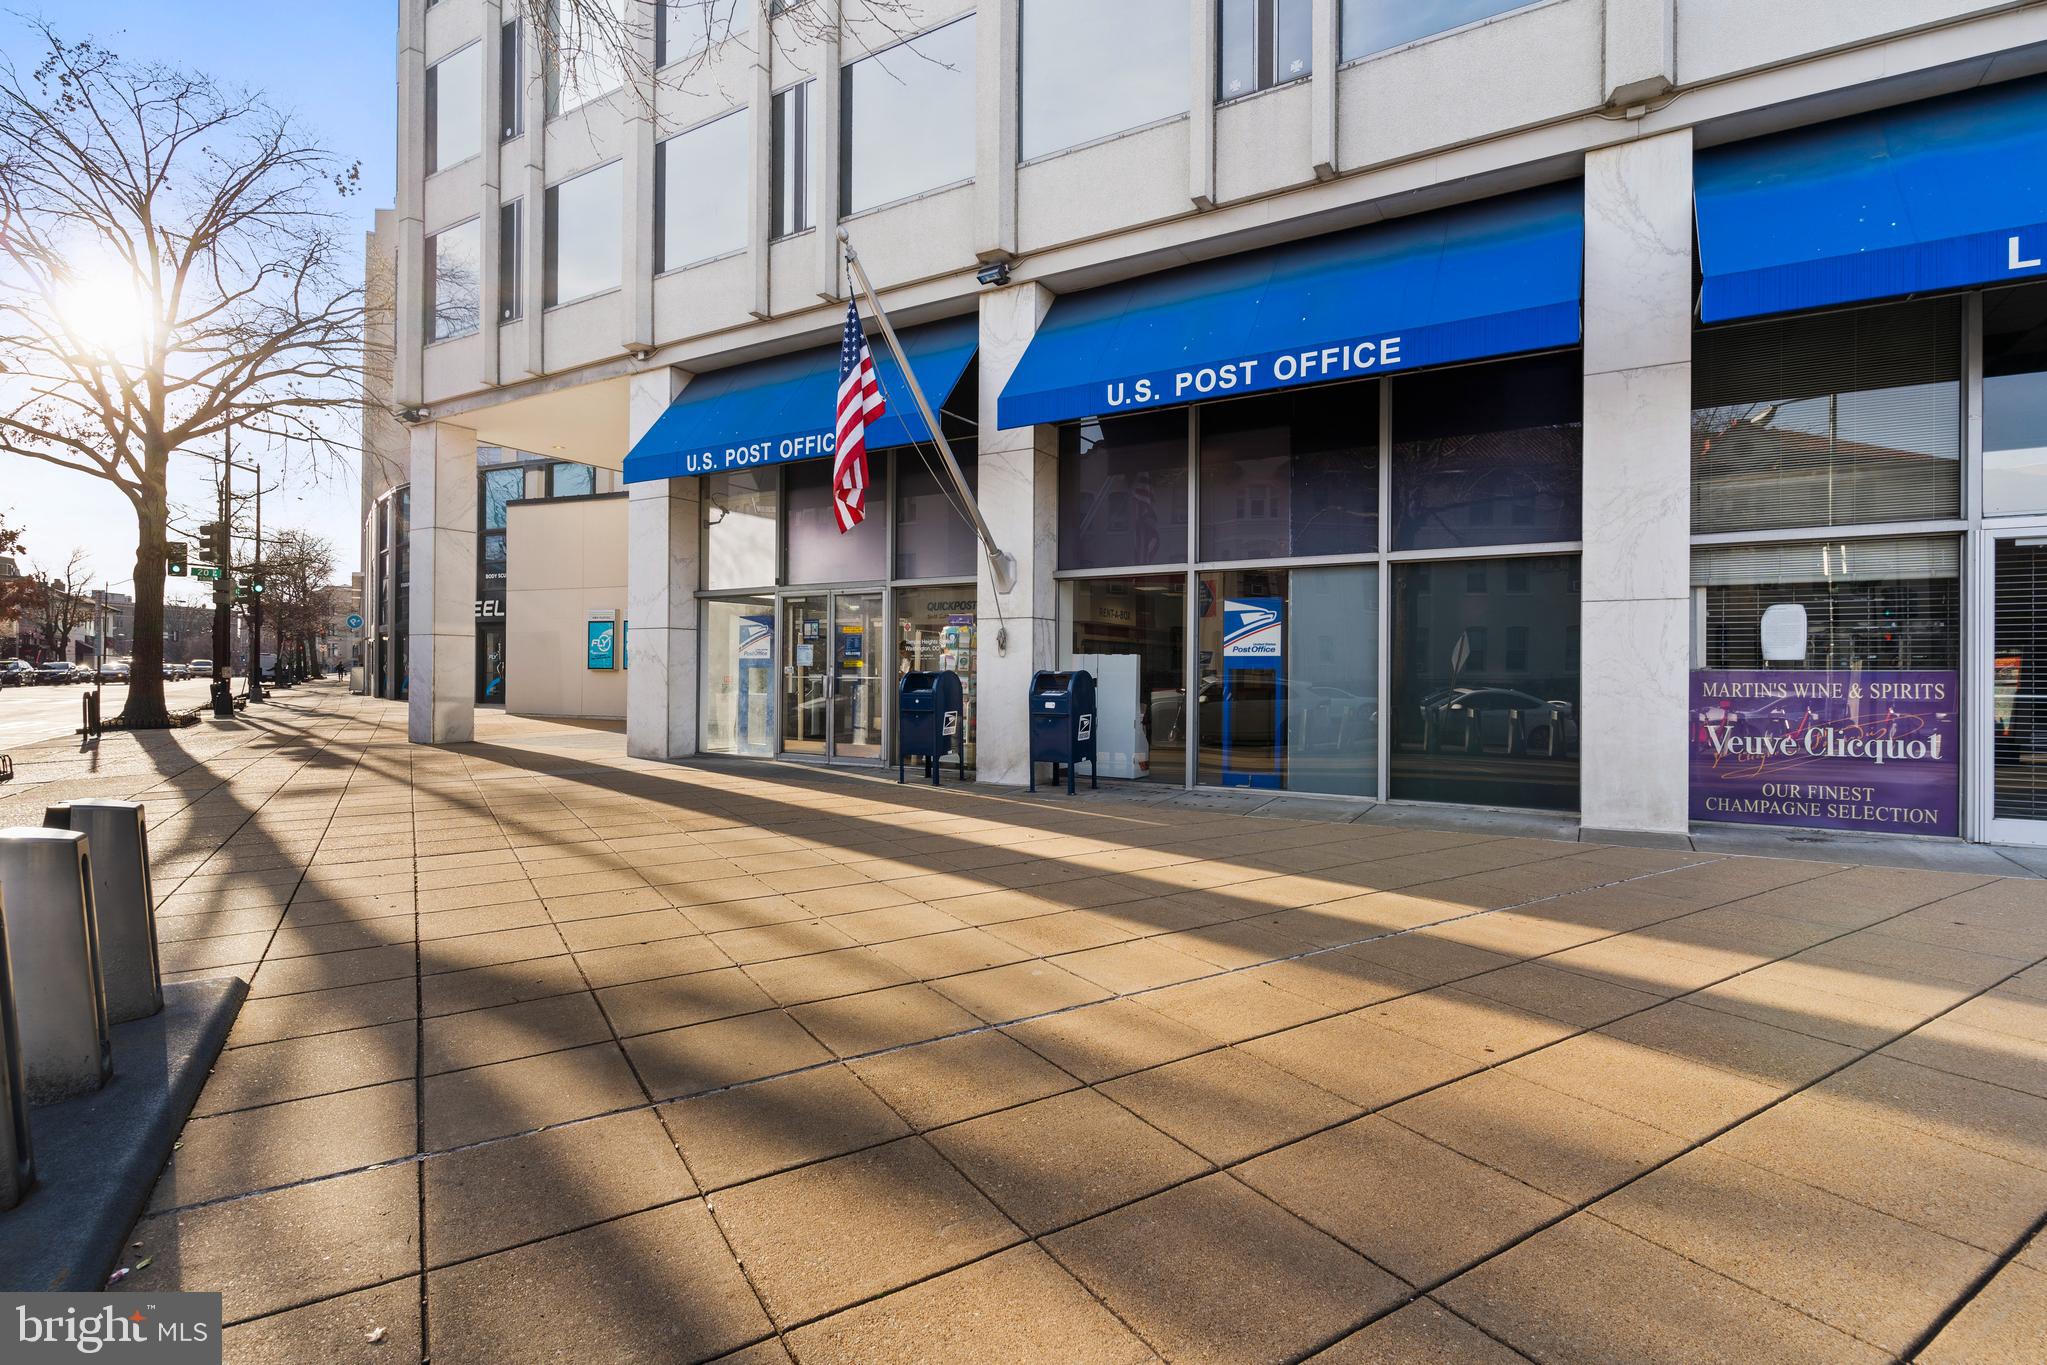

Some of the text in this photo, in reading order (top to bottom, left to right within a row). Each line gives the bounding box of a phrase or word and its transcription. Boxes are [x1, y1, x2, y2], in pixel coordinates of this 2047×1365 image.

[2008, 236, 2041, 270] L
[1107, 337, 1401, 406] U.S. POST OFFICE
[686, 452, 717, 472] U.S.
[725, 442, 771, 467] POST
[927, 601, 977, 612] QUICKPOST
[1703, 682, 1945, 700] MARTIN'S WINE & SPIRITS
[1704, 725, 1797, 756] Veuve
[1804, 726, 1942, 764] Clicquot
[1762, 783, 1875, 802] OUR FINEST
[1705, 797, 1938, 824] CHAMPAGNE SELECTION
